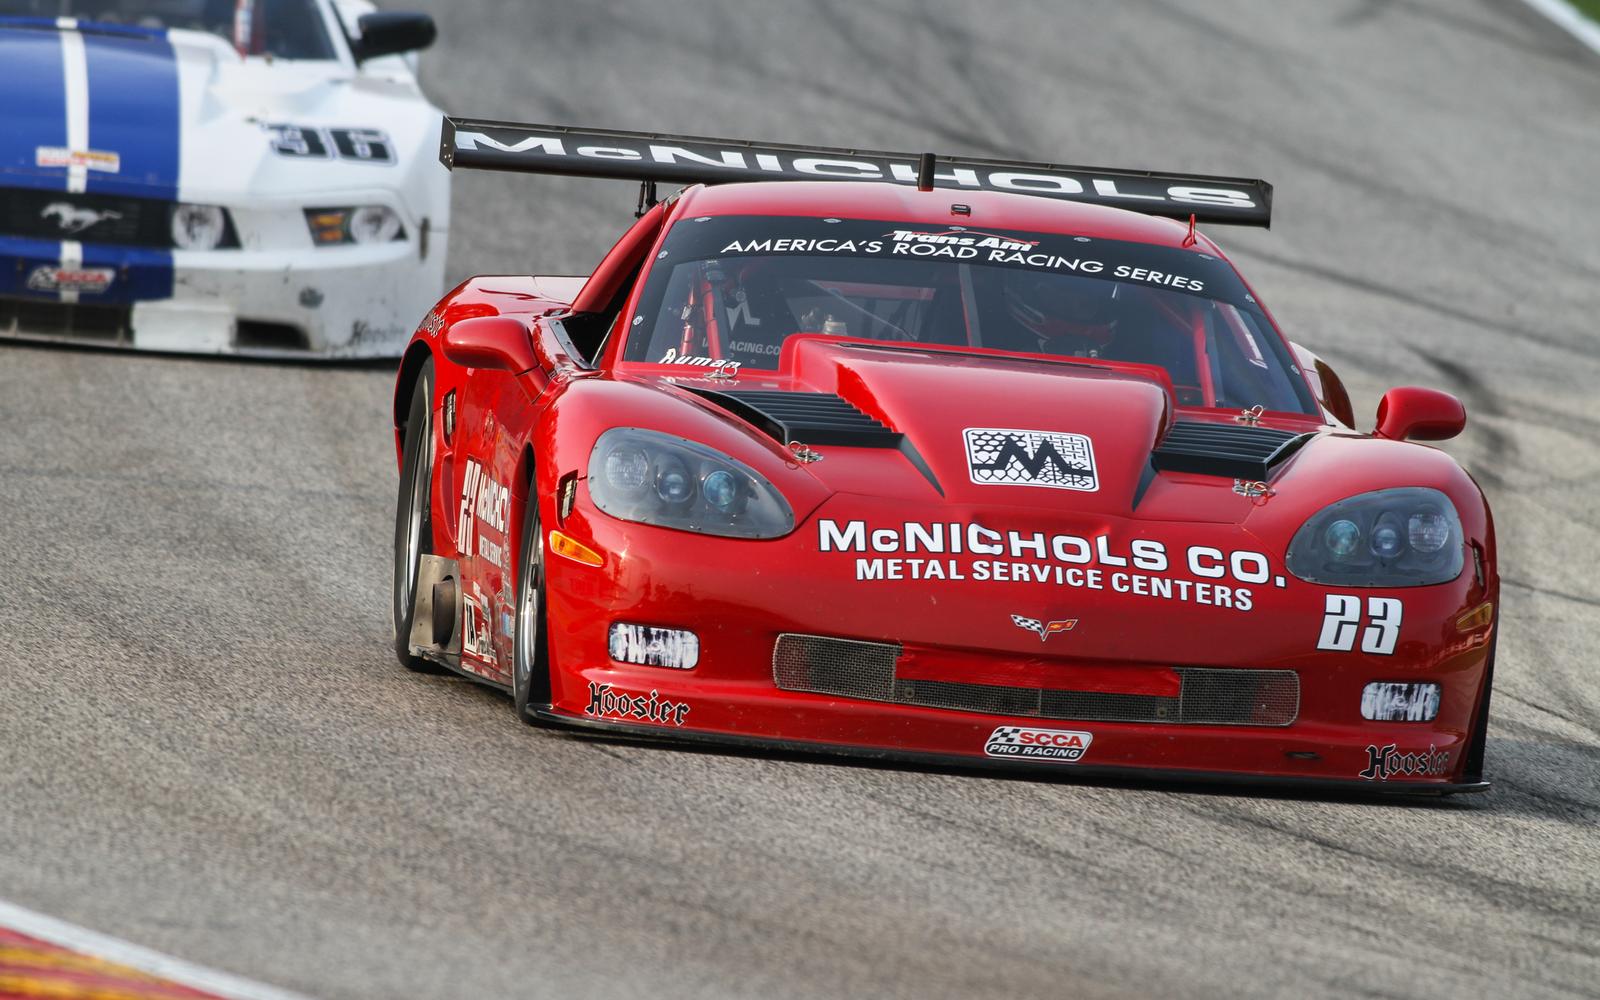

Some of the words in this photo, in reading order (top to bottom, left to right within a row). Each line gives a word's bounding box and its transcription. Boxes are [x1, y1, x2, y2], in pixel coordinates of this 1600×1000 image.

[454, 130, 1257, 208] McNICHOLS
[720, 238, 882, 254] AMERICA'S
[892, 242, 978, 260] ROAD
[988, 250, 1104, 273] RACING
[1113, 265, 1204, 292] SERIES
[817, 518, 1169, 573] McNICHOLS
[1187, 545, 1288, 589] CO.
[856, 557, 966, 581] METAL
[971, 559, 1104, 590] SERVICE
[1110, 571, 1254, 612] CENTERS
[1315, 593, 1404, 656] 23
[585, 680, 691, 726] Hoosier
[988, 744, 1019, 754] PRO
[1022, 746, 1080, 758] RACING
[1019, 731, 1083, 748] SCCA
